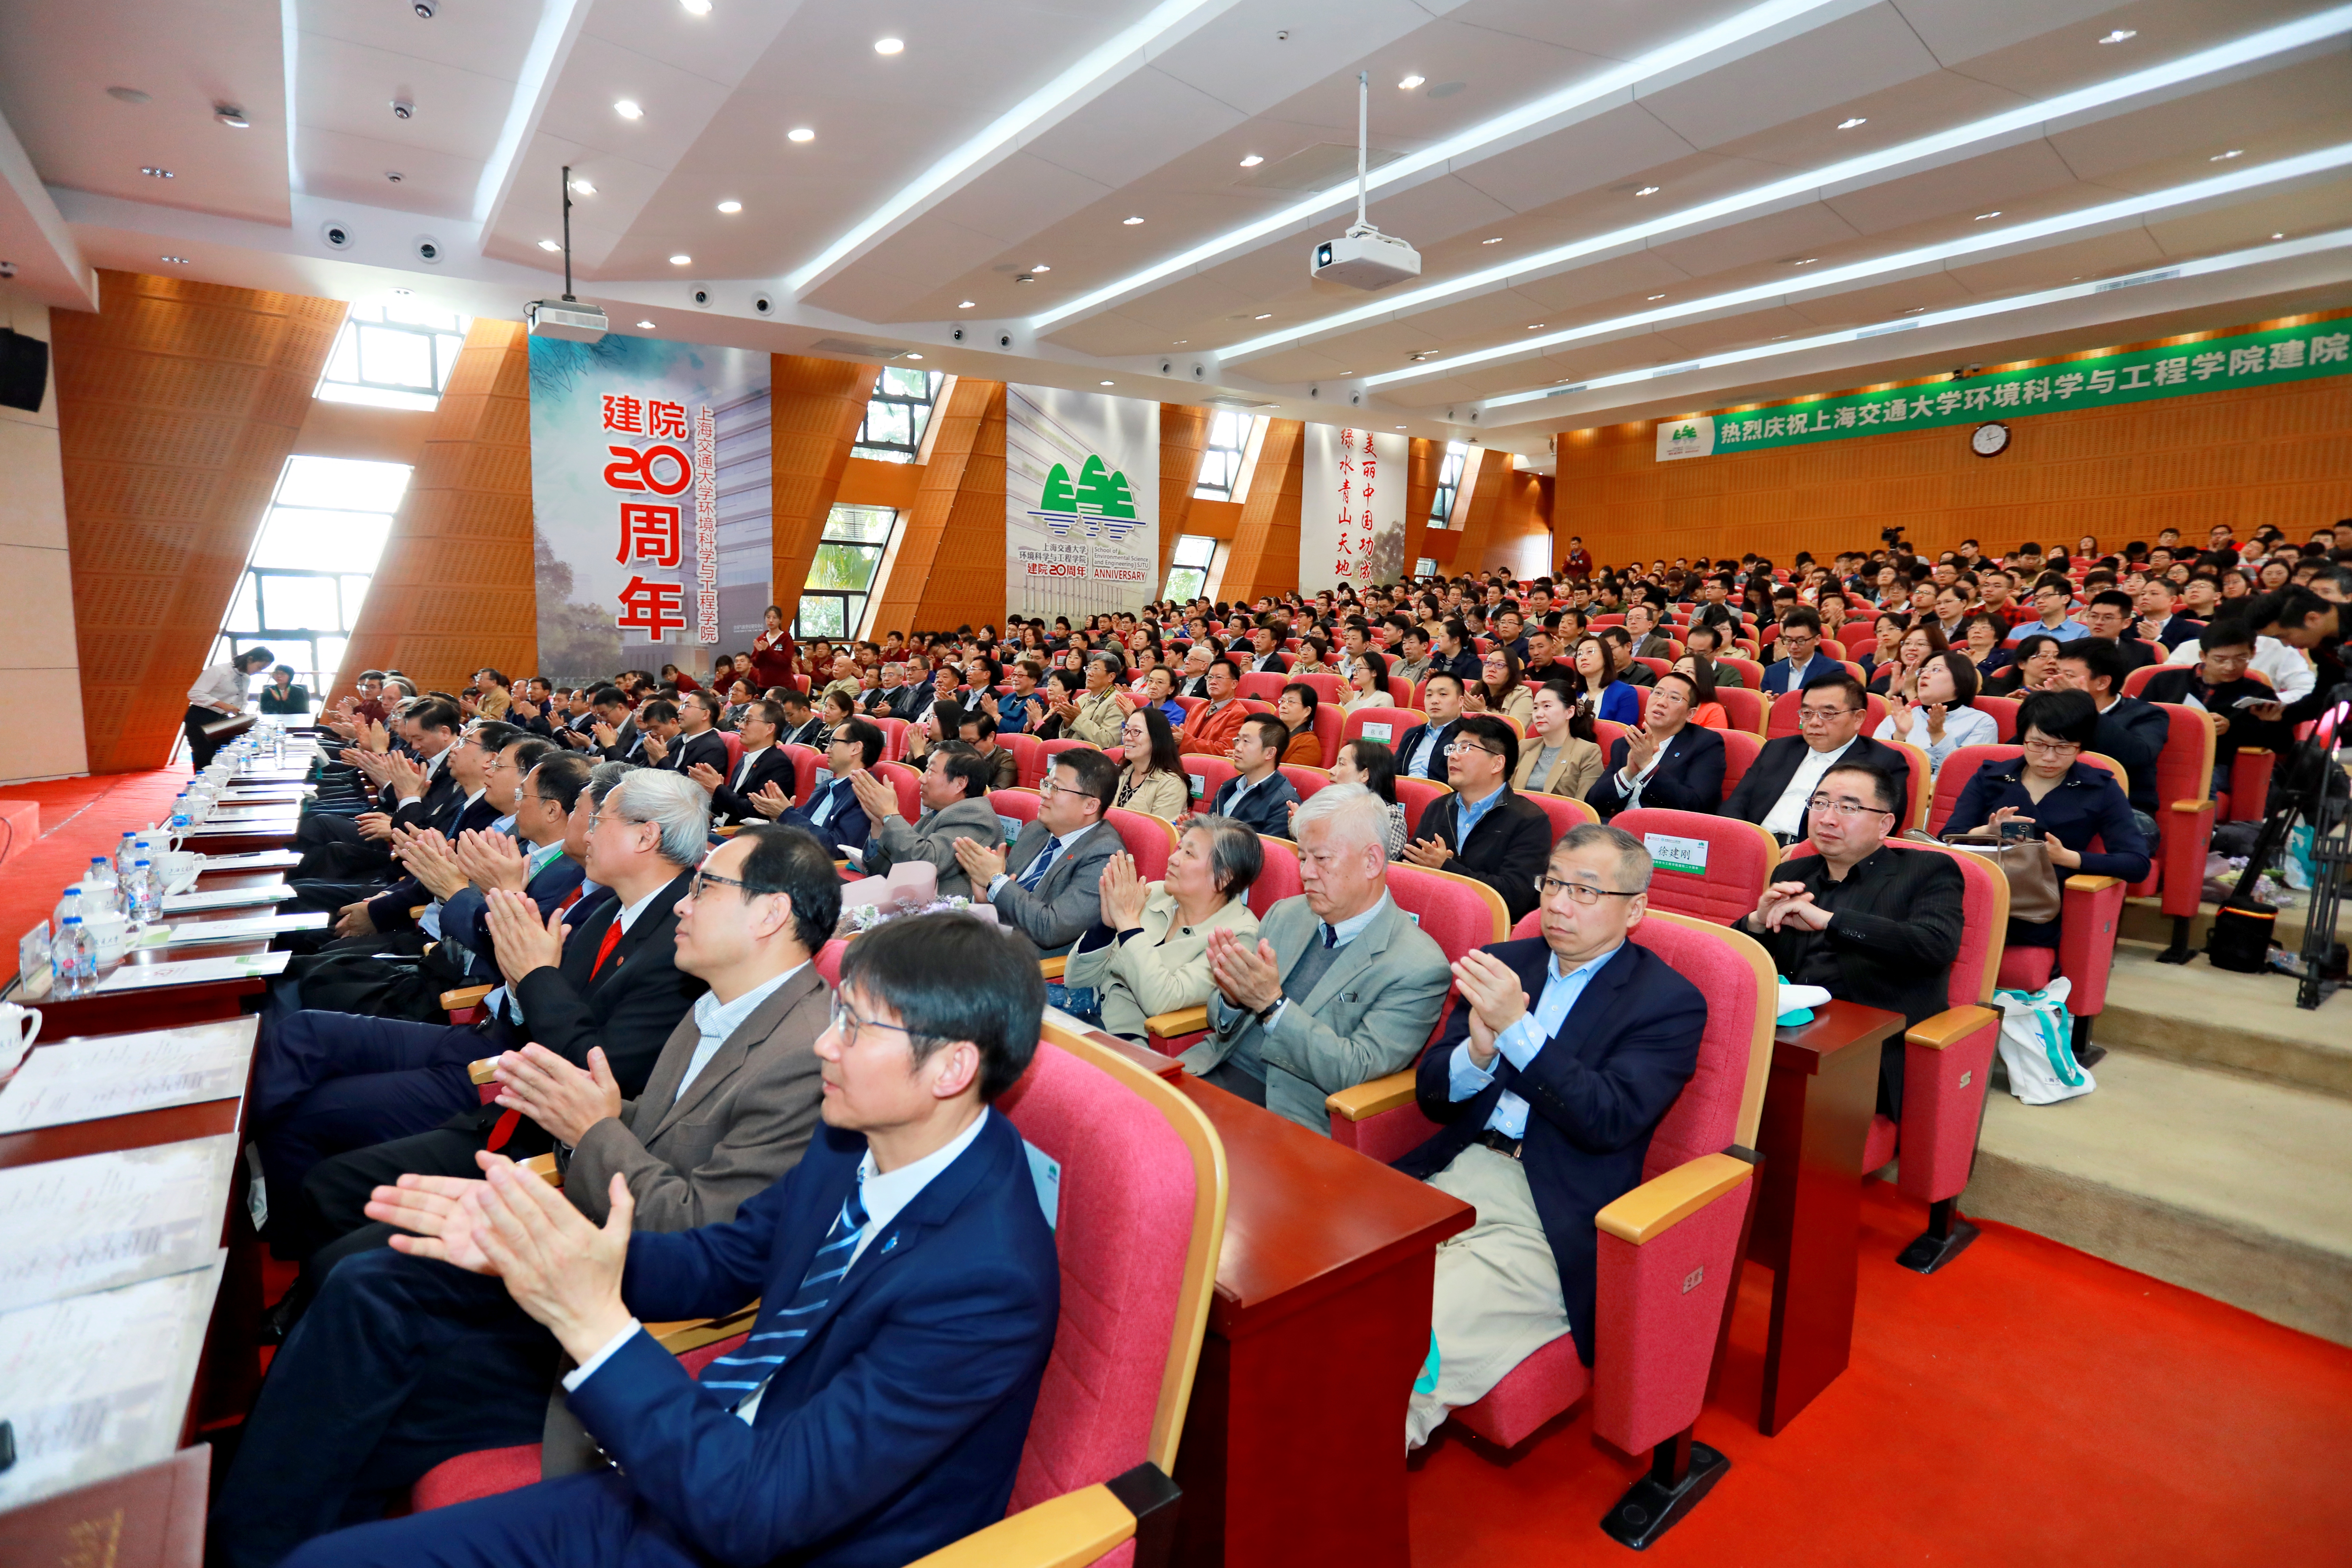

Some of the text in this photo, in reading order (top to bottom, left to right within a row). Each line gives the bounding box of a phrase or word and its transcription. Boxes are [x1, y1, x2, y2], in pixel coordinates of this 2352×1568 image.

[1721, 332, 2350, 444] 热烈庆祝上海交通大学环境科学与工程学院建院
[603, 395, 687, 439] 建院
[603, 445, 691, 496] 20
[696, 405, 719, 642] 上海交通大学环境科学与工程学院
[1335, 428, 1355, 599] 绿水青山天地
[1019, 551, 1086, 563] 环境科学与工程学院
[1042, 543, 1086, 554] 上海交通大学
[616, 502, 685, 640] 周年
[1027, 563, 1086, 577] 建院20周年
[1094, 568, 1145, 581] ANNIVERSARY
[1105, 560, 1134, 568] Engineering
[1658, 846, 1690, 860] 徐建刚
